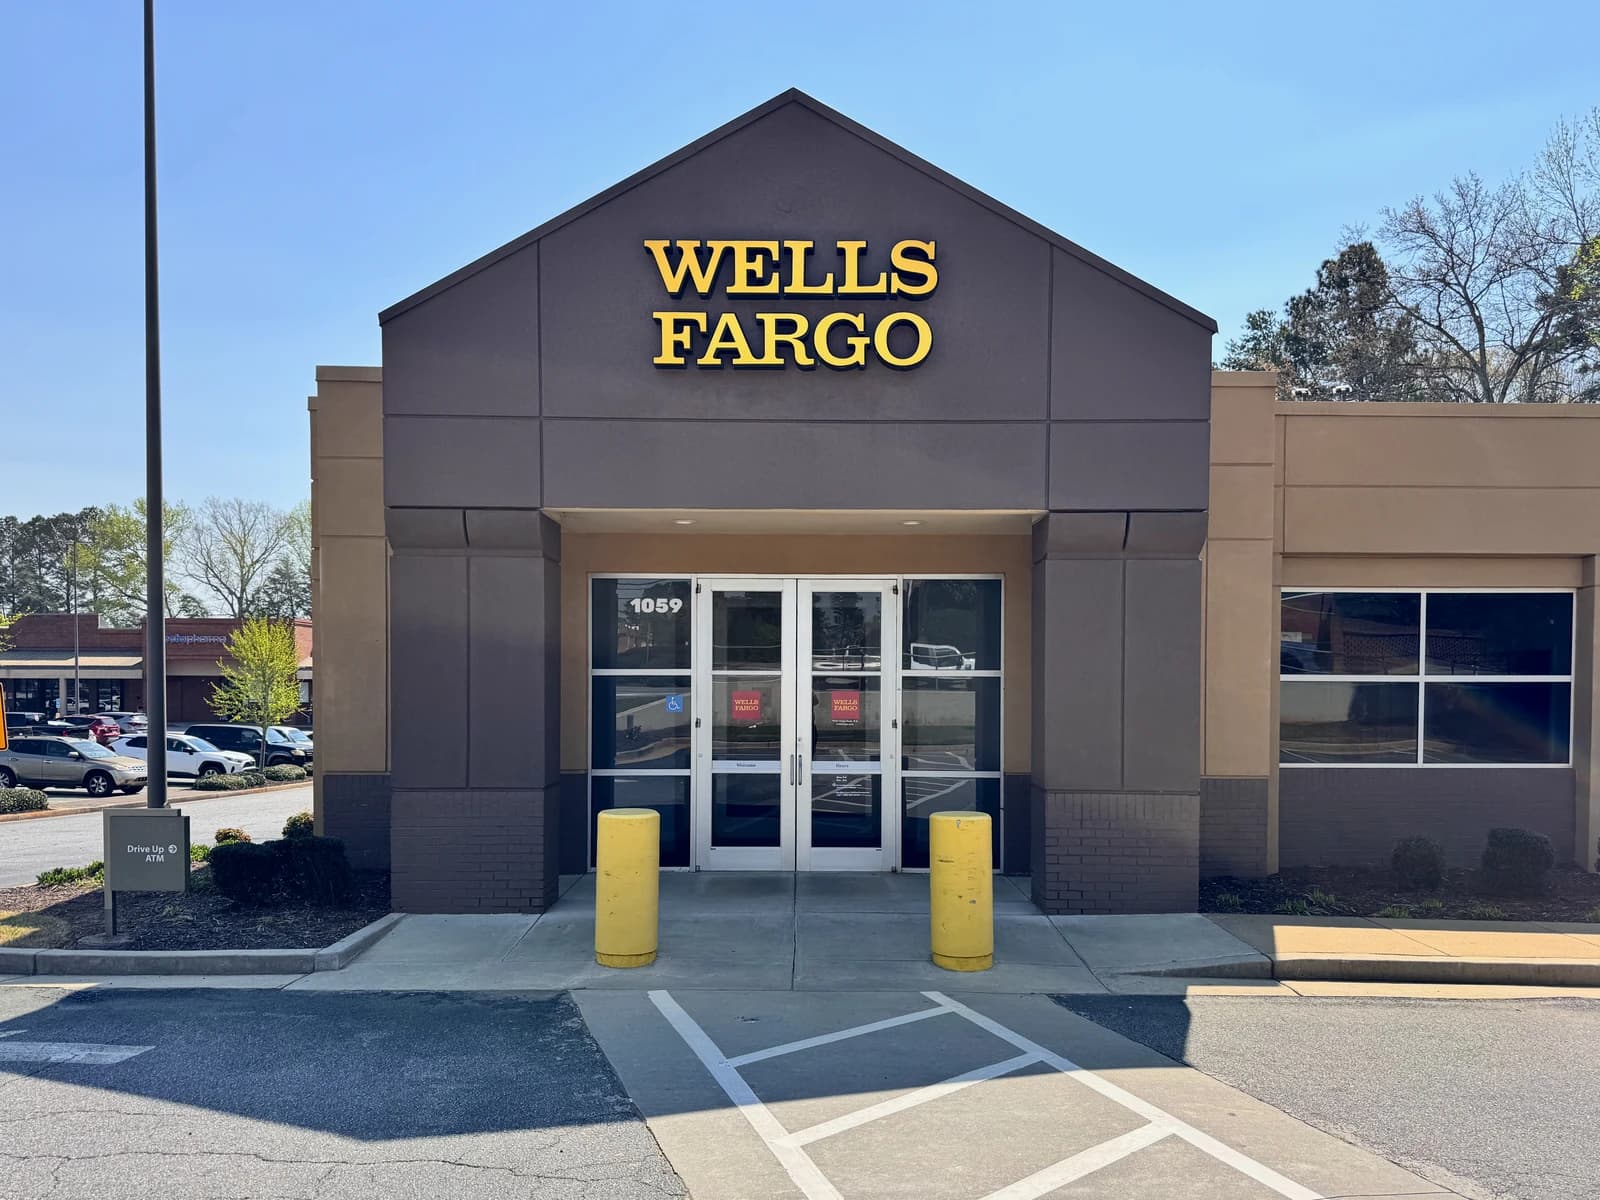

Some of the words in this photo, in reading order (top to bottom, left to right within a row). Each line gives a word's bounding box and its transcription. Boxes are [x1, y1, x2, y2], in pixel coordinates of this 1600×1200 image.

[643, 239, 939, 296] WELLS
[652, 311, 934, 369] FARGO
[630, 598, 683, 613] 1059
[127, 845, 150, 853] Drive
[151, 845, 165, 854] Up
[145, 854, 165, 863] ATM
